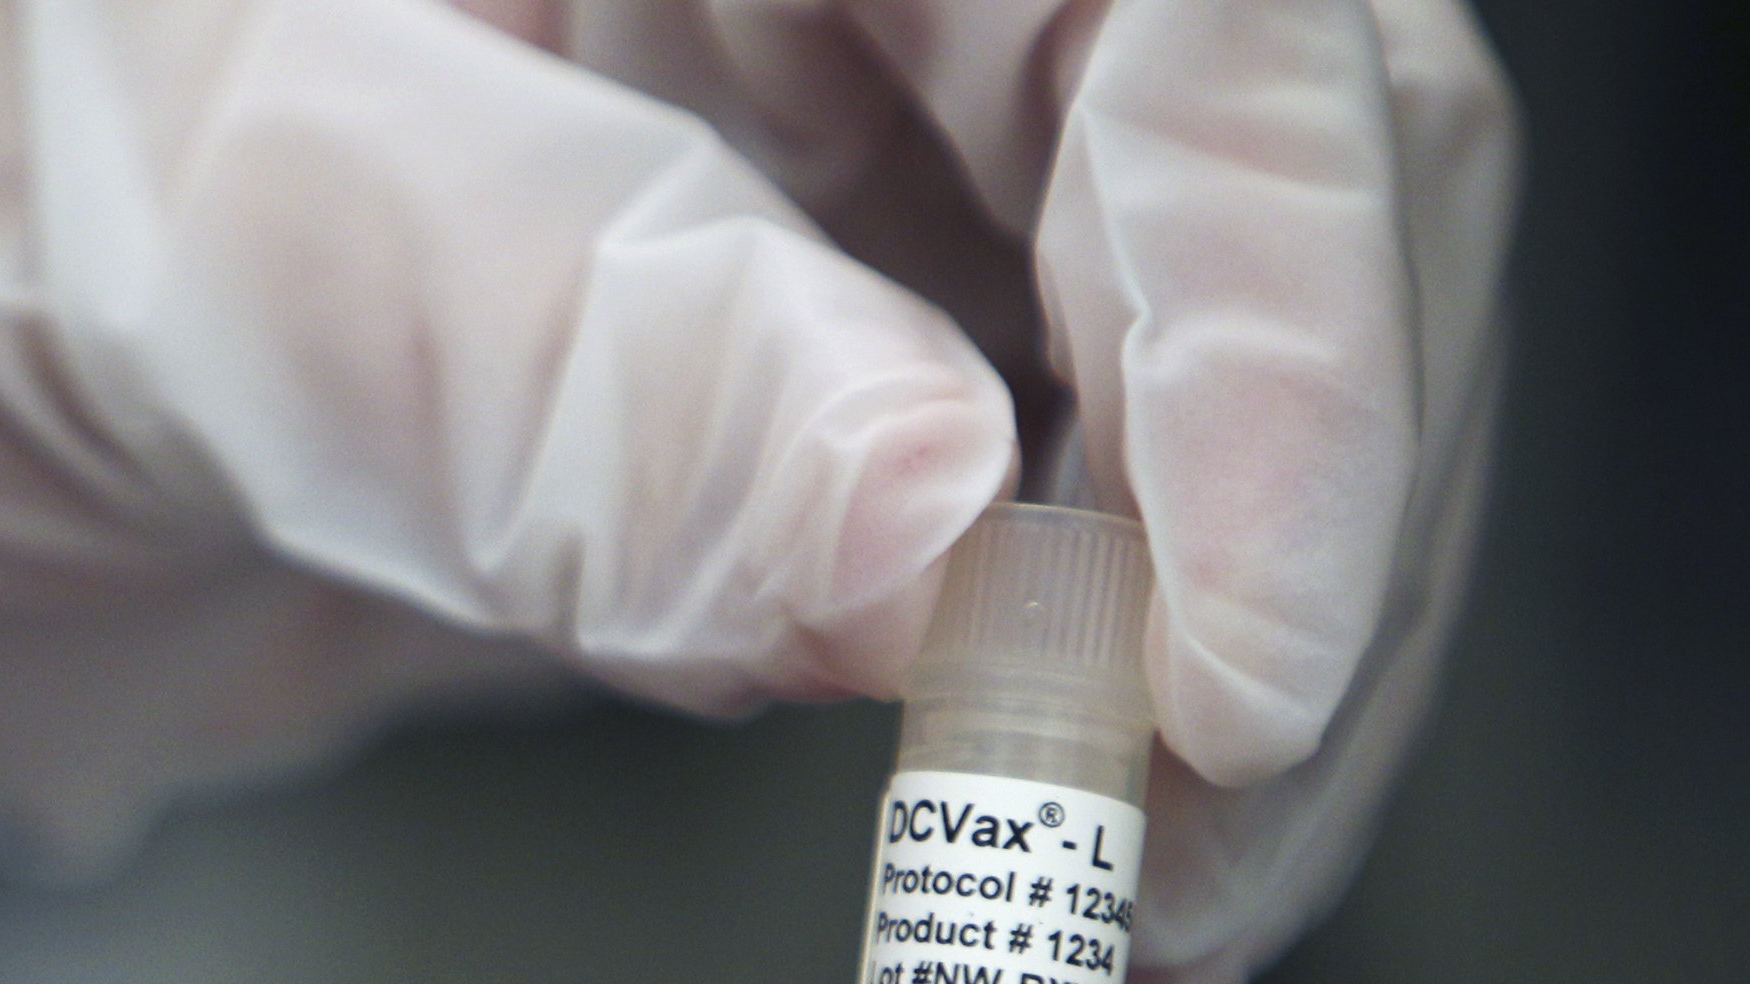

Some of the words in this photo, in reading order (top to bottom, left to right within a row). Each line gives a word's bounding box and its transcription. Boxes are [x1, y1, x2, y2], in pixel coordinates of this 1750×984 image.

[1091, 825, 1113, 871] L
[883, 863, 1016, 902] Protocol
[1029, 876, 1053, 907] #
[875, 912, 997, 950] Product
[1008, 922, 1033, 954] #
[1048, 930, 1114, 976] 1234
